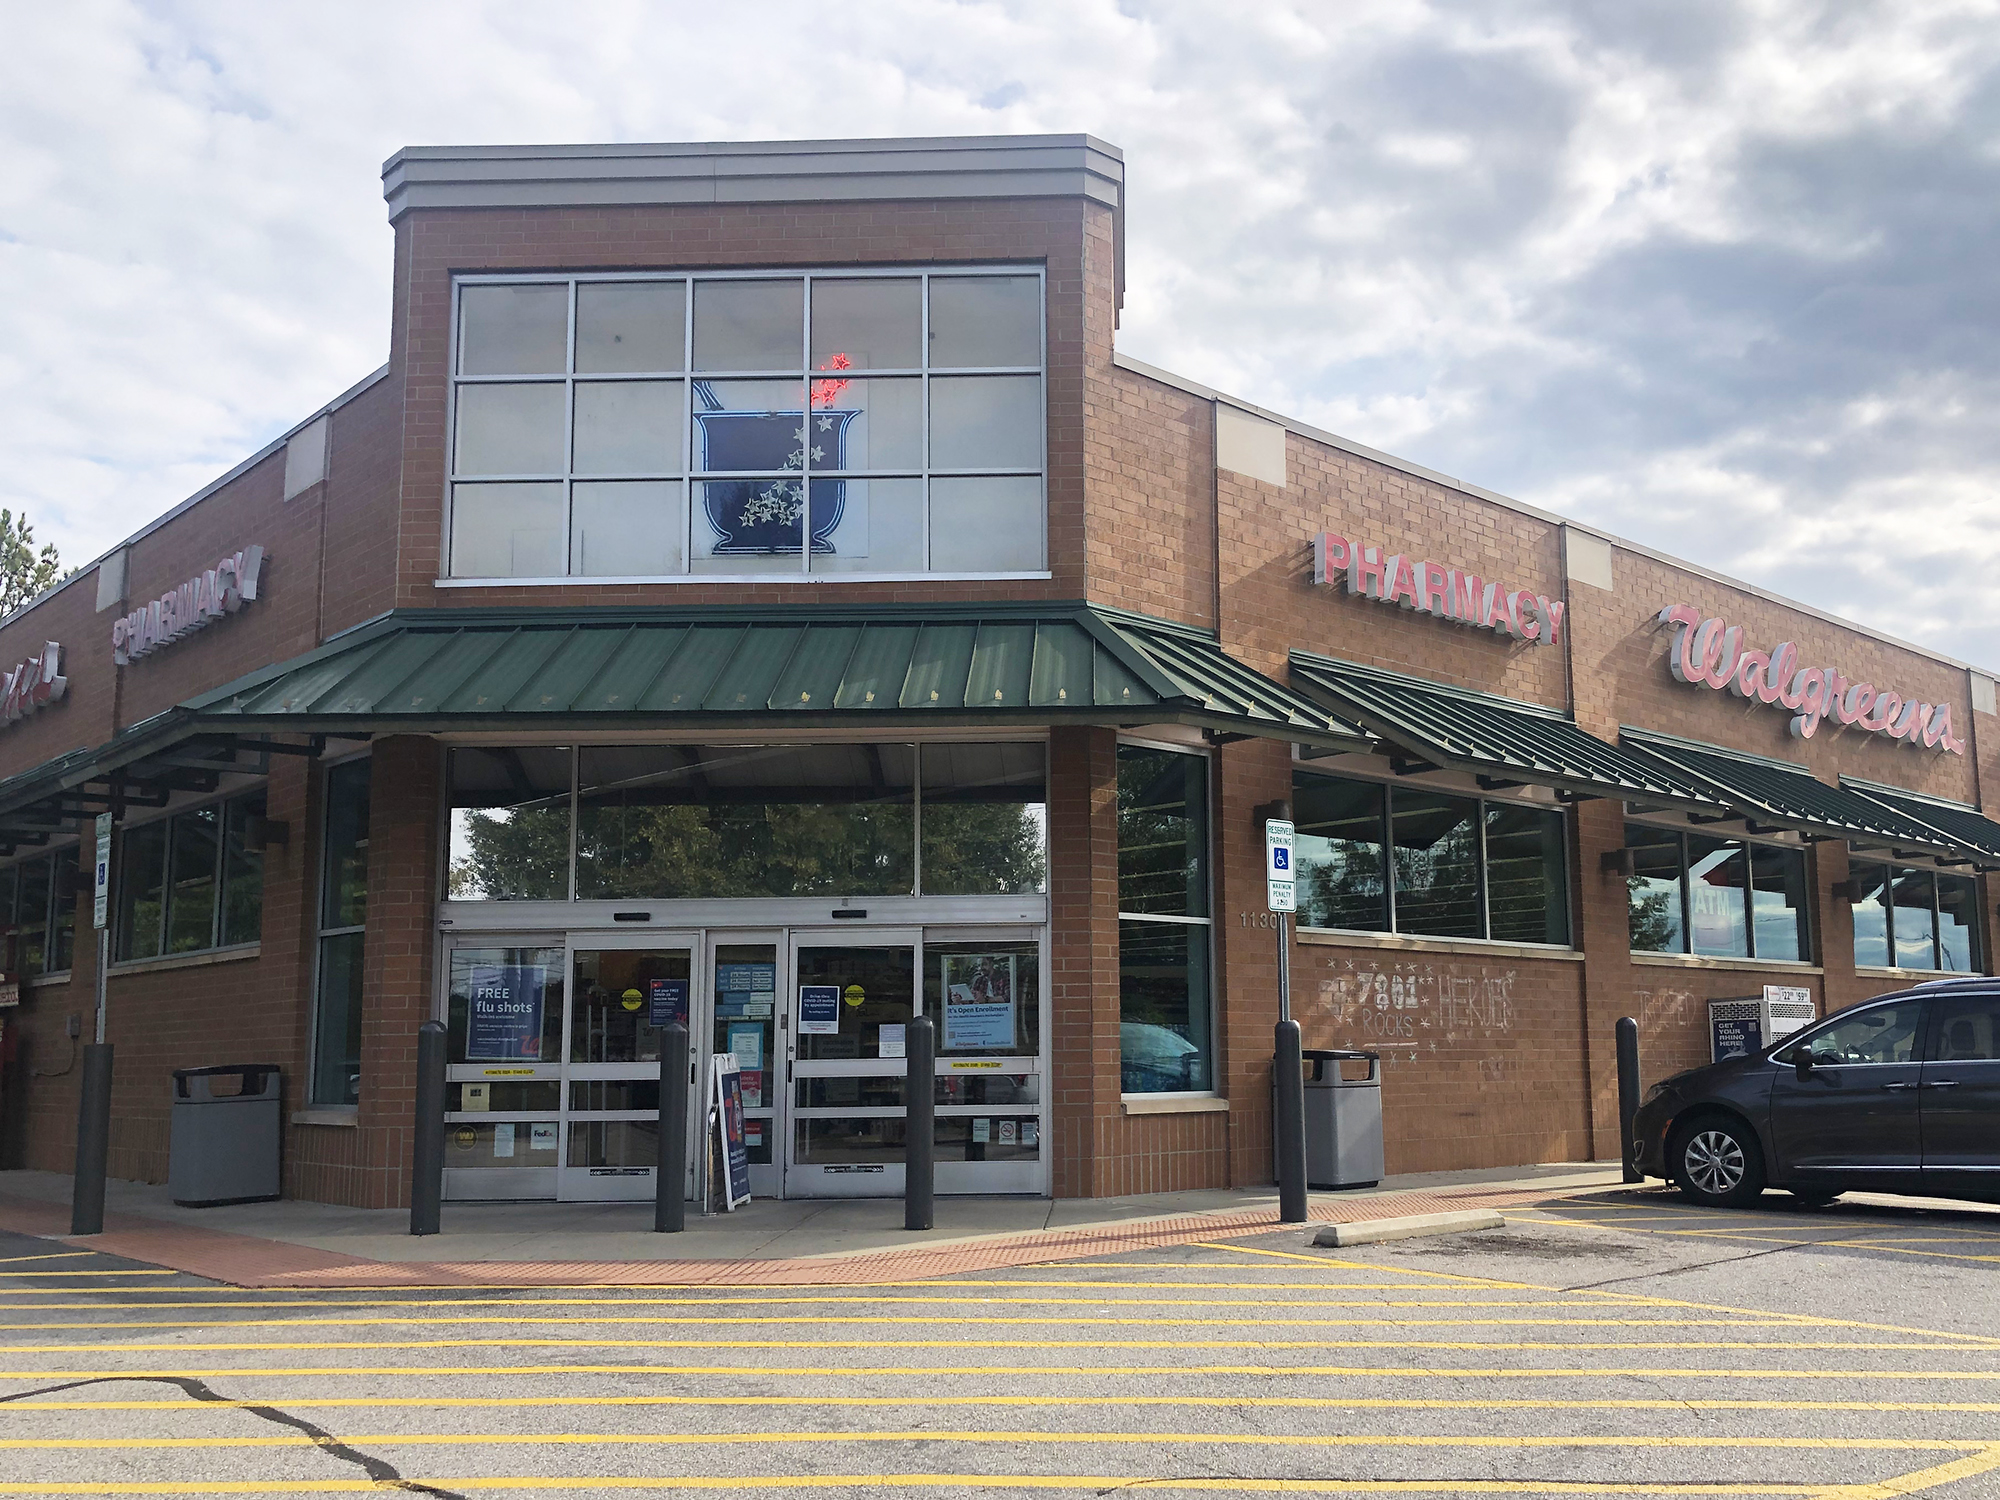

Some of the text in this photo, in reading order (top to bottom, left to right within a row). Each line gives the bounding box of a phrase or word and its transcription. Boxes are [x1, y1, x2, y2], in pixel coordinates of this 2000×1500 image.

[1314, 531, 1564, 645] PHARMACY
[113, 545, 264, 665] PHARMACY
[1658, 603, 1967, 756] Walgreens
[1268, 825, 1292, 835] RESERVED
[1269, 836, 1291, 846] PARKING
[1273, 890, 1291, 898] PENALTY
[1694, 888, 1730, 916] ATM
[1240, 911, 1277, 930] 1130
[477, 988, 510, 999] FREE
[476, 1001, 494, 1013] flu
[1362, 1008, 1414, 1038] ROCKS
